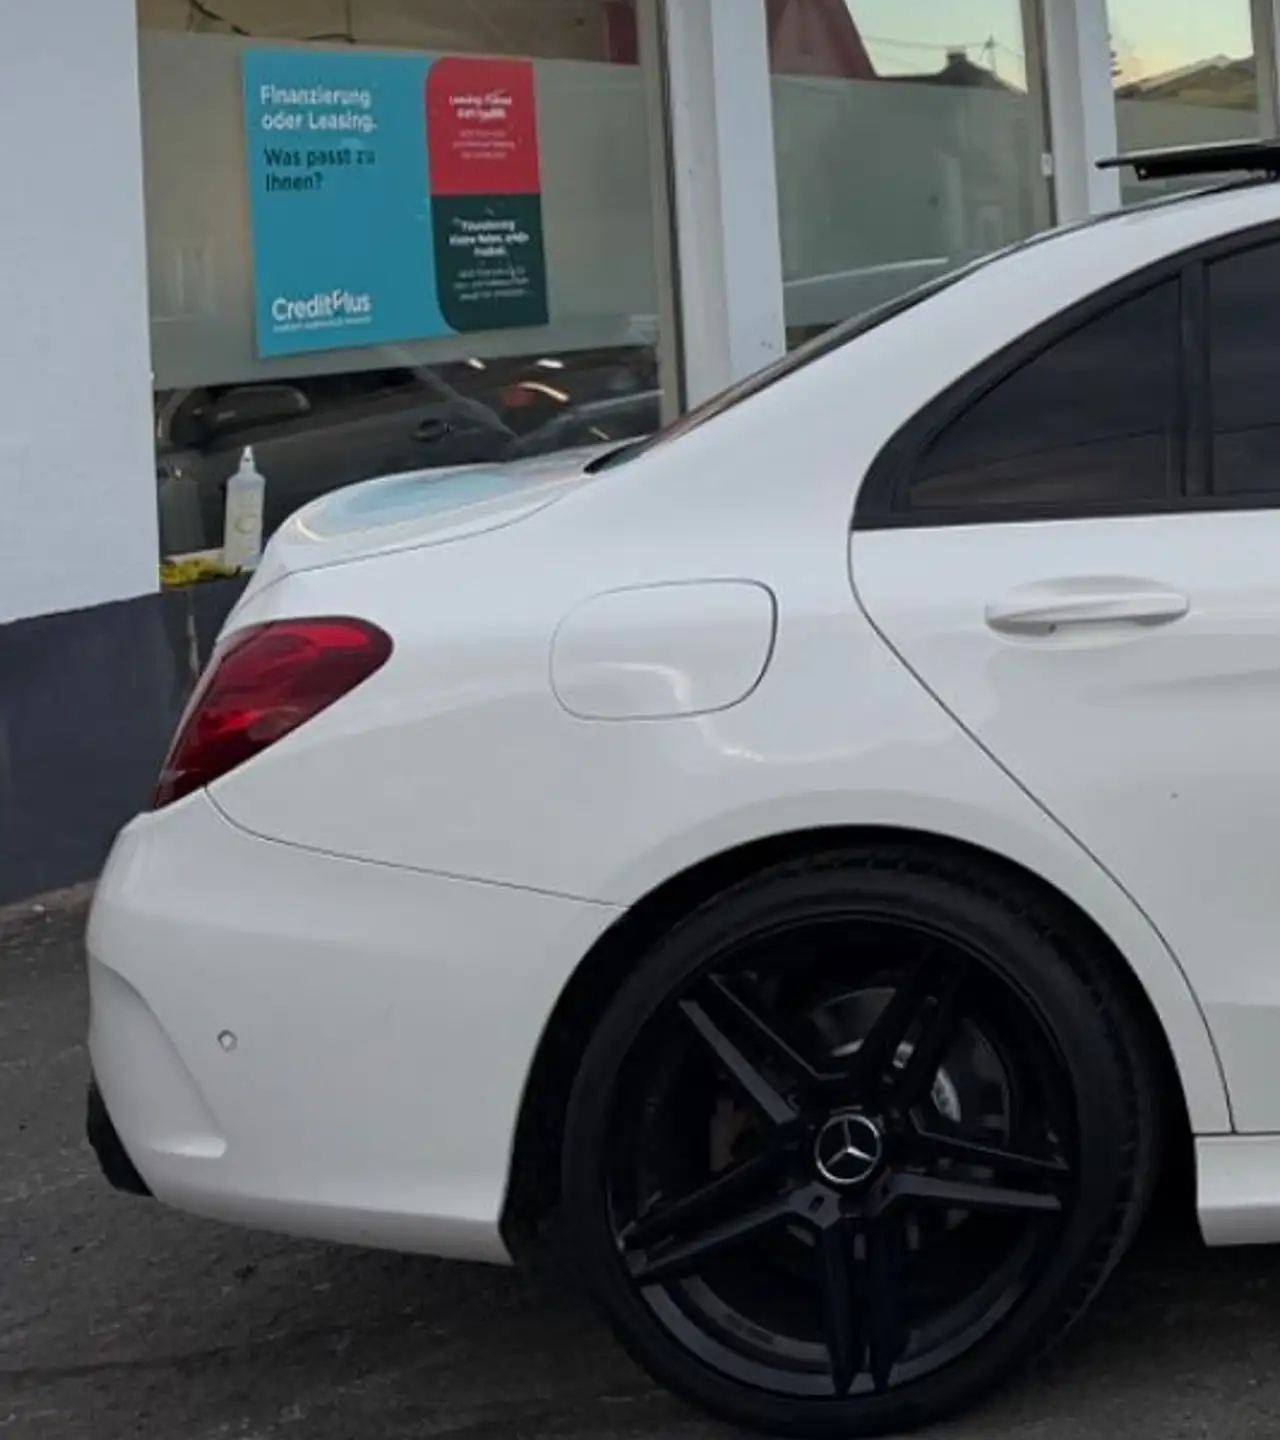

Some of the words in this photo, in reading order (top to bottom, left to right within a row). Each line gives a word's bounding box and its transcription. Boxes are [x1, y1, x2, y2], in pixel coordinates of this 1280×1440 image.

[260, 83, 371, 110] Finanzierung
[261, 111, 302, 130] oder
[263, 146, 302, 167] Was
[307, 147, 351, 169] passt
[265, 171, 324, 192] Ihnen?
[271, 288, 371, 321] CreditPlus
